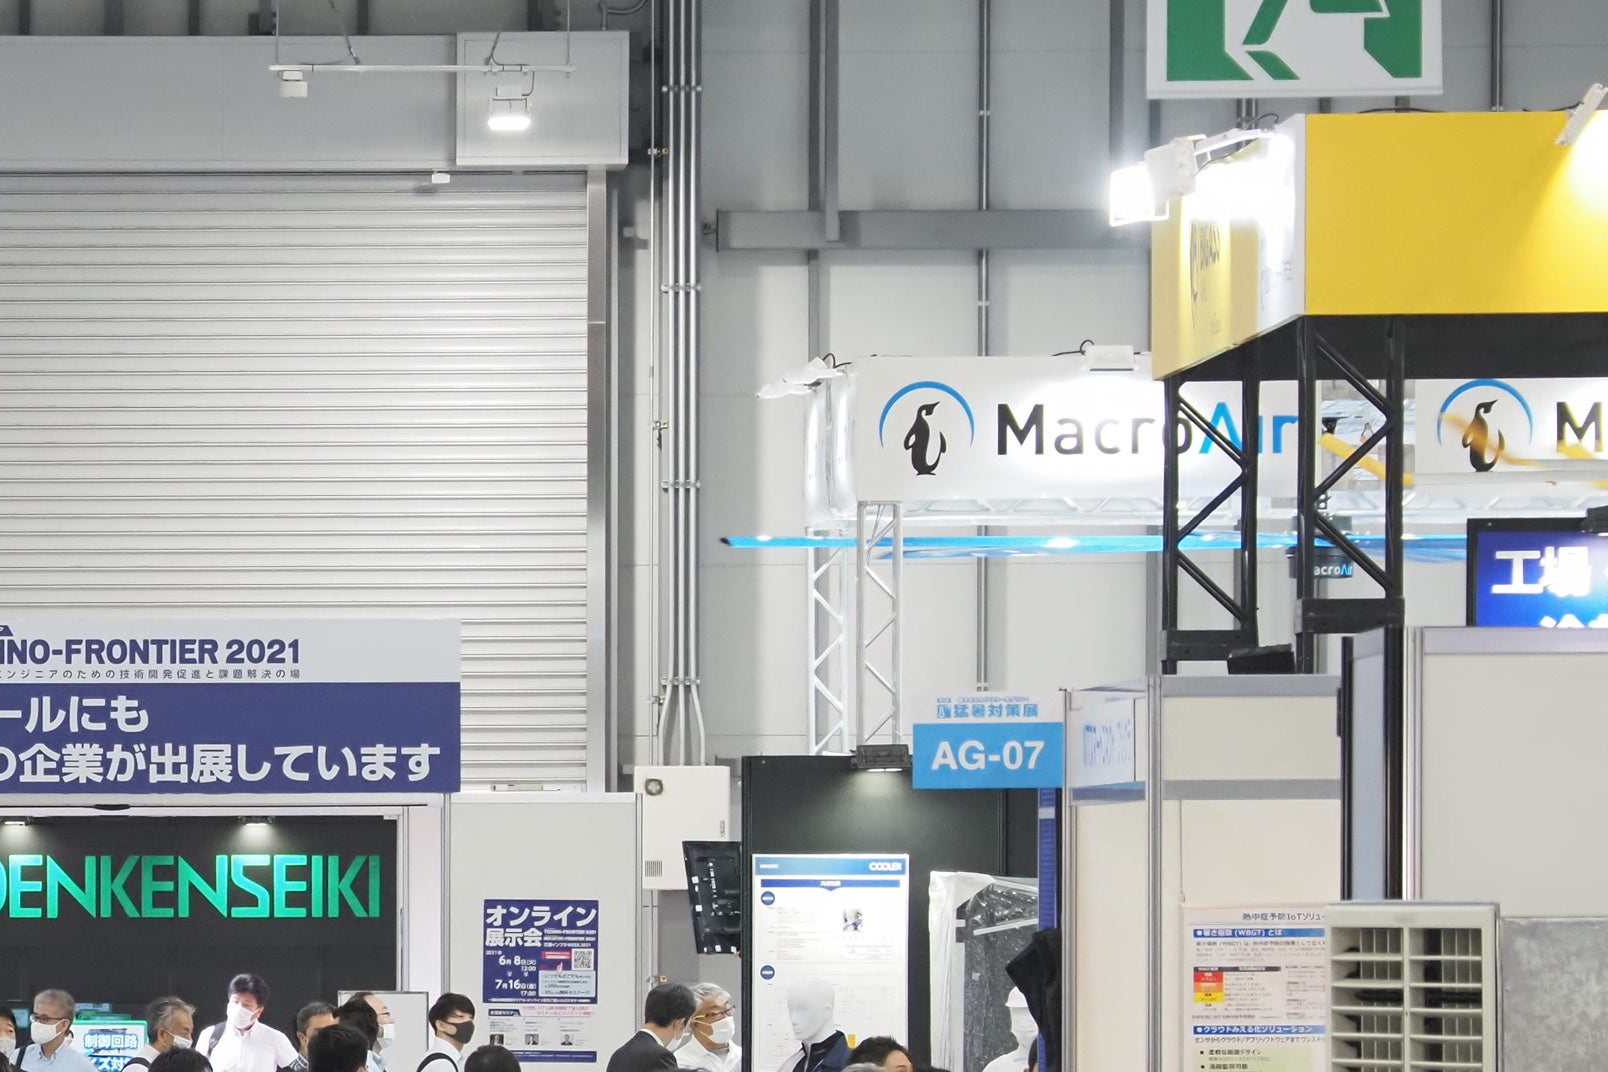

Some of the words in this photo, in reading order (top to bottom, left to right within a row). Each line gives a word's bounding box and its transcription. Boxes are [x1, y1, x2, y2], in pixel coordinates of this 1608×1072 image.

[1314, 564, 1352, 576] acroAir
[226, 639, 299, 664] 2021
[932, 740, 1045, 770] AG-07
[485, 905, 597, 927] オンライン
[485, 928, 542, 948] 展示会
